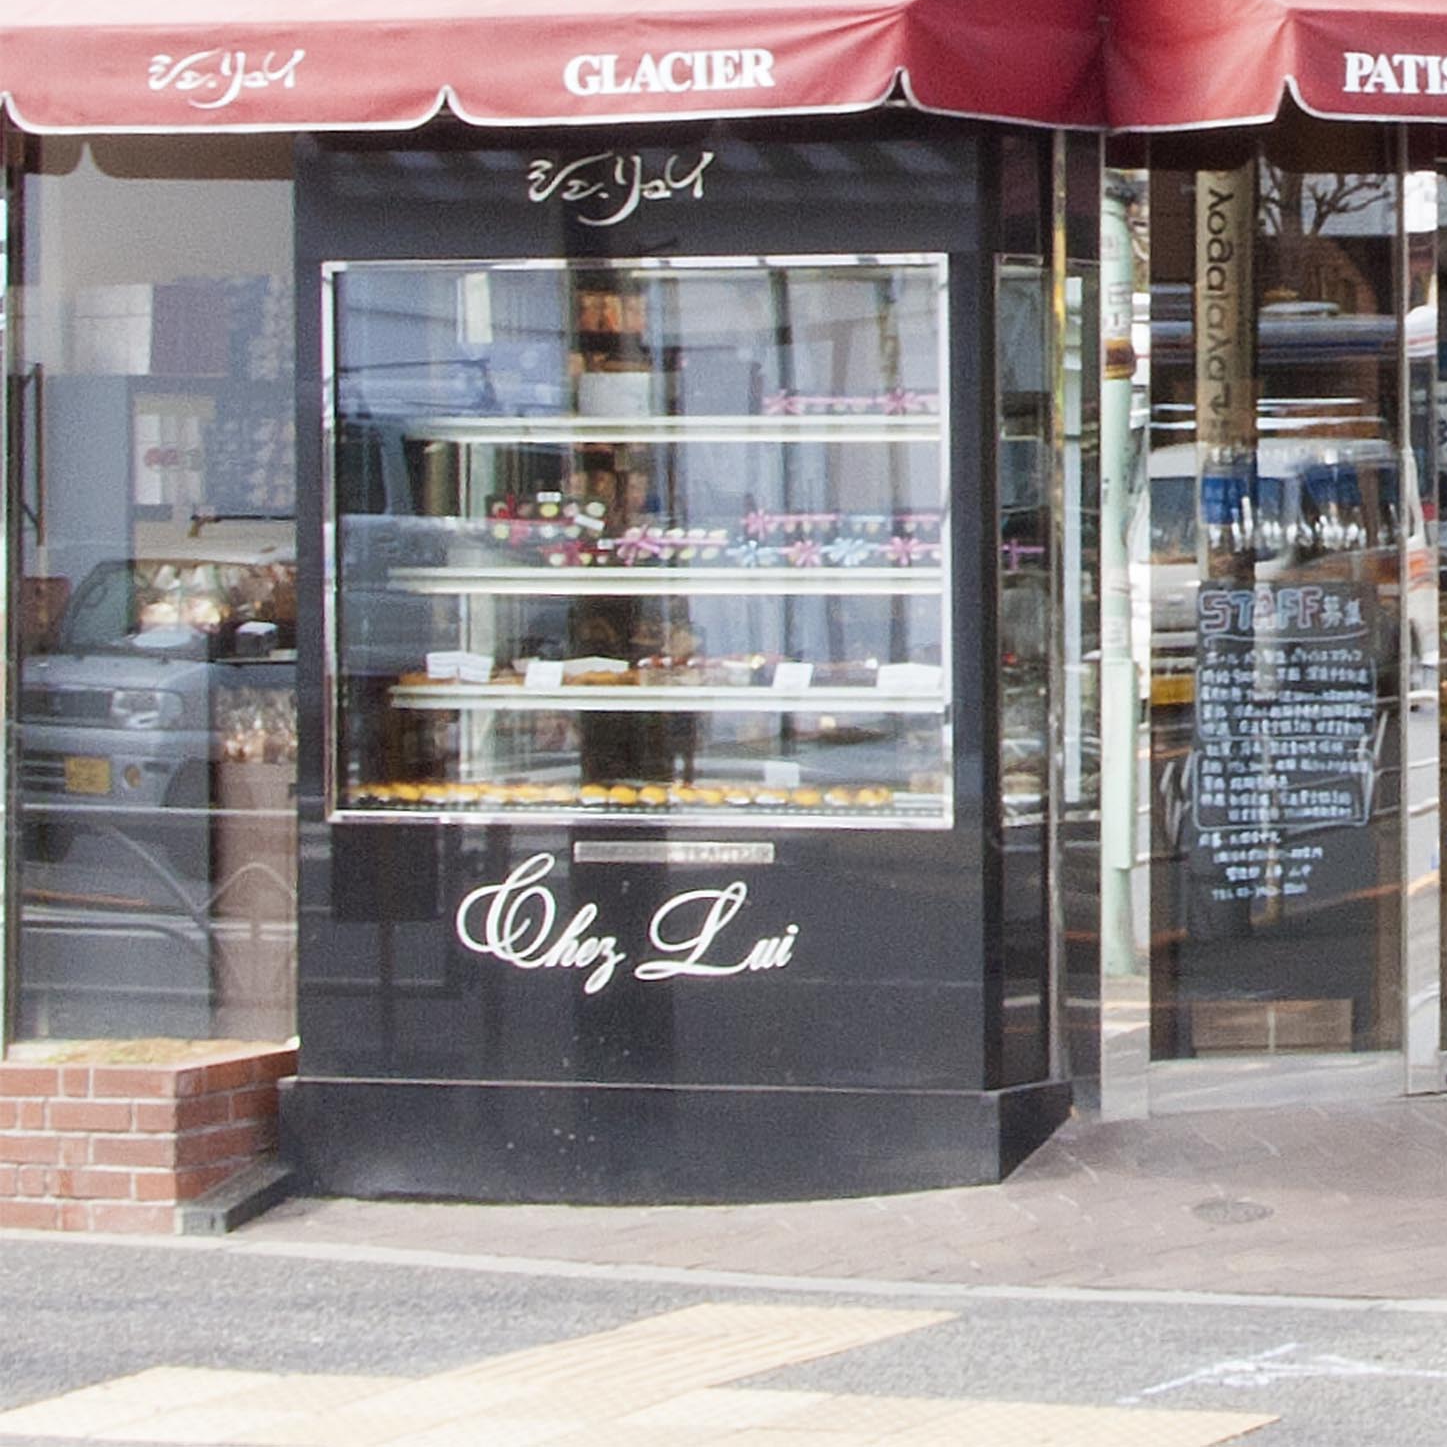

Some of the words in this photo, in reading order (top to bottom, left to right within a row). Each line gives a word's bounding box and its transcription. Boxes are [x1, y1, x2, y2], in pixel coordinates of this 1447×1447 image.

[563, 48, 776, 97] GLACIER
[1199, 585, 1324, 634] STAFF
[456, 852, 626, 995] Chez
[633, 881, 799, 982] Lui
